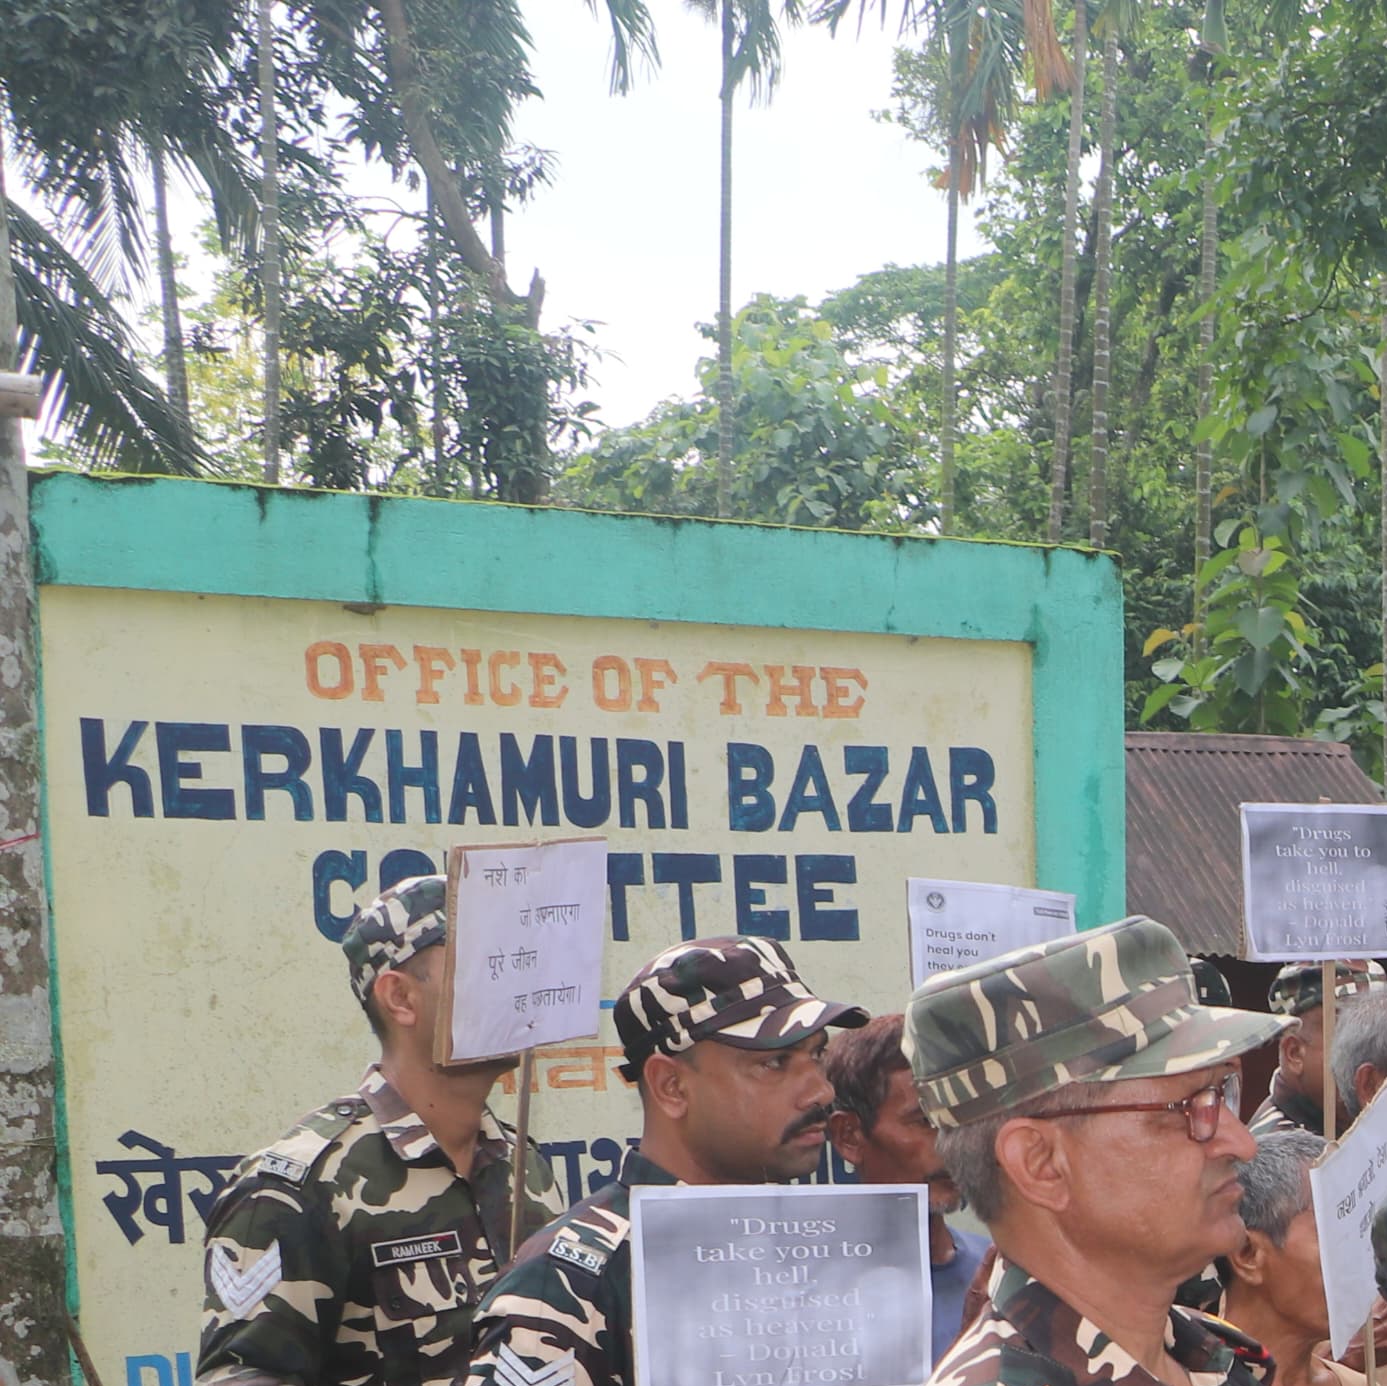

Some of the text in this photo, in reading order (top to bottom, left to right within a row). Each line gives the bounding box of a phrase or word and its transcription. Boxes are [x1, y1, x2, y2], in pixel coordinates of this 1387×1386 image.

[304, 640, 868, 719] OFFICE OF THE
[79, 717, 997, 833] KERKHAMURI BAZAR
[1275, 845, 1371, 859] take you to
[483, 861, 527, 887] नशे का
[1285, 879, 1366, 895] disguised
[1278, 899, 1297, 911] as
[1304, 914, 1365, 929] Donald
[926, 928, 962, 942] Drugs
[1285, 932, 1367, 948] Lyn Frost
[927, 945, 979, 958] heal you
[488, 946, 538, 981] पूरे जीवन
[514, 993, 528, 1013] वह
[730, 1217, 836, 1236] "Drugs
[391, 1240, 443, 1259] RAMNEEK
[695, 1240, 873, 1263] take you to
[711, 1287, 861, 1314] disguised
[699, 1322, 733, 1339] as
[750, 1338, 860, 1361] Donald
[787, 1364, 865, 1384] Frost
